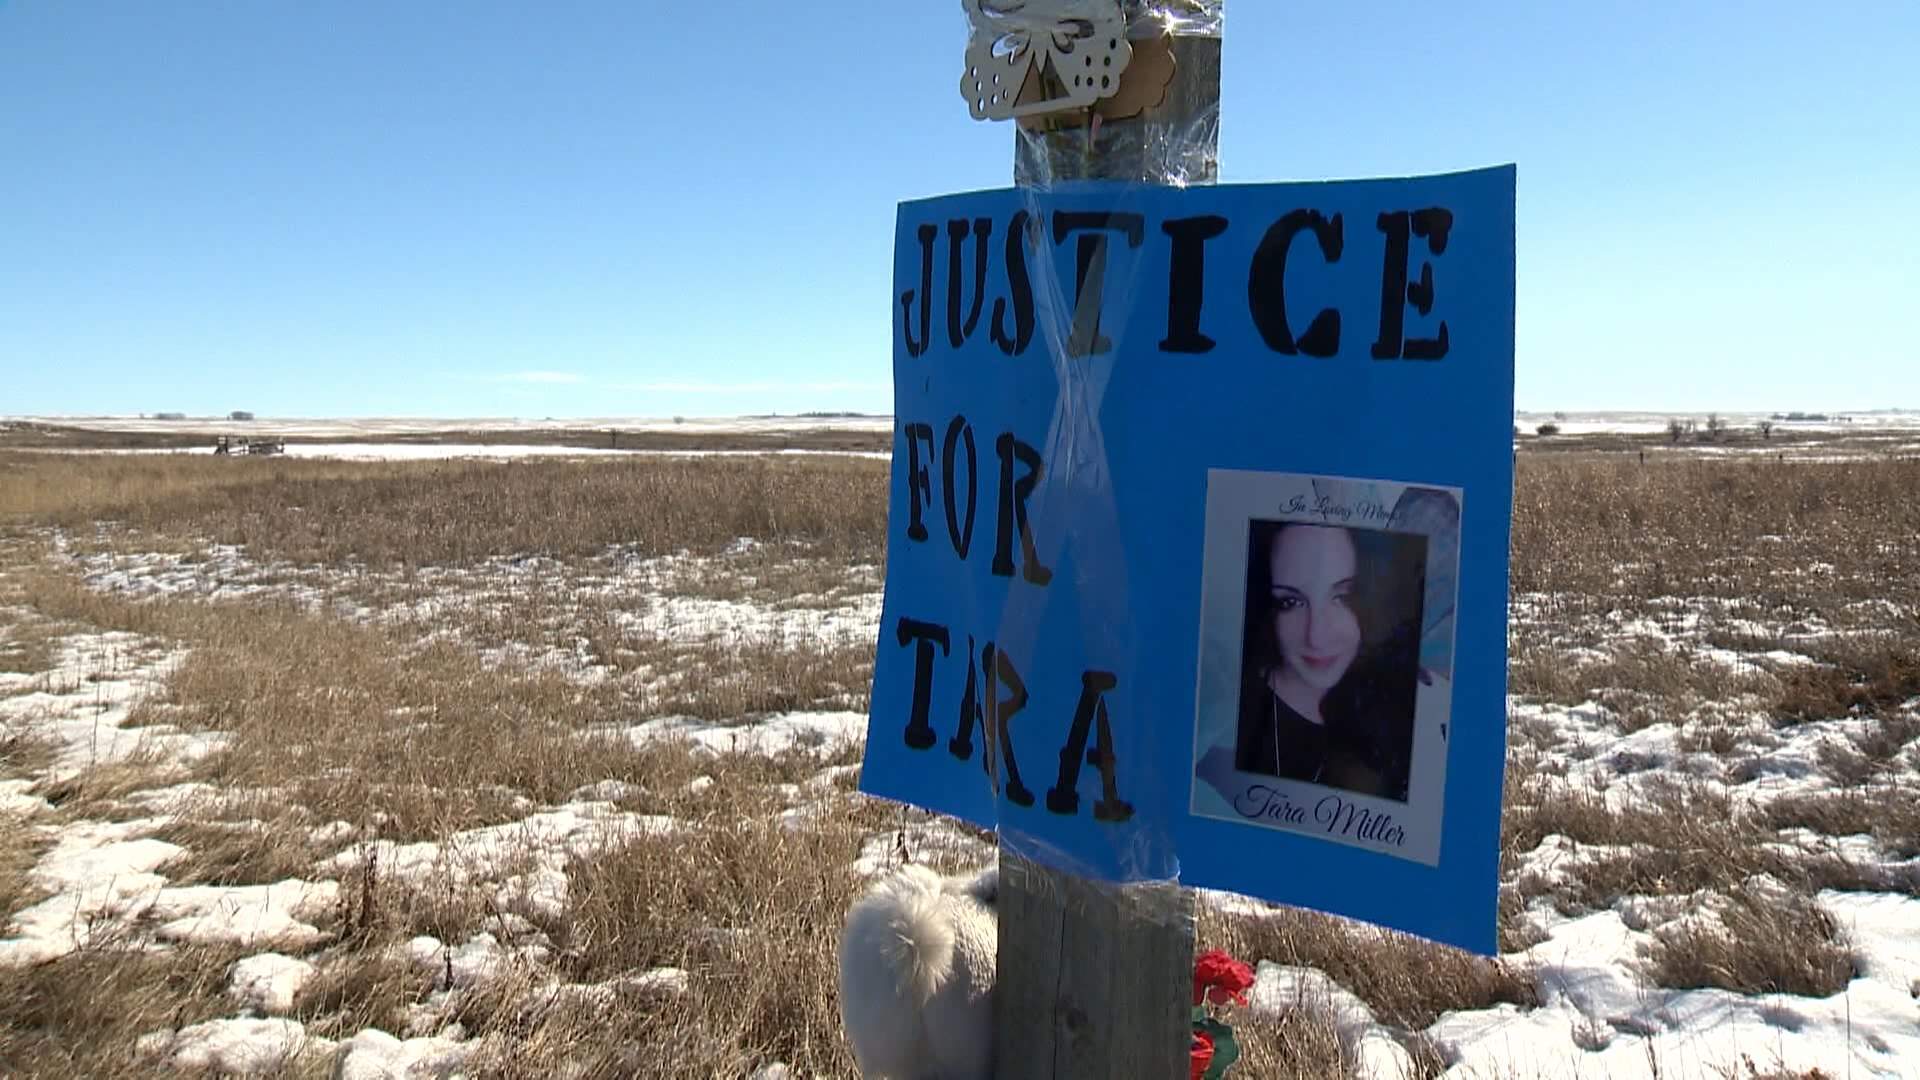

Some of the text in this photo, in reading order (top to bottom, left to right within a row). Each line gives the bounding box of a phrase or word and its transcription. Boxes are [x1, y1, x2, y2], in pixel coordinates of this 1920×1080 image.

[901, 208, 1453, 361] JUSTICE
[904, 415, 1053, 587] FOR
[1279, 494, 1305, 513] In
[896, 617, 1136, 822] TARA
[1234, 784, 1406, 846] Tara Miller
